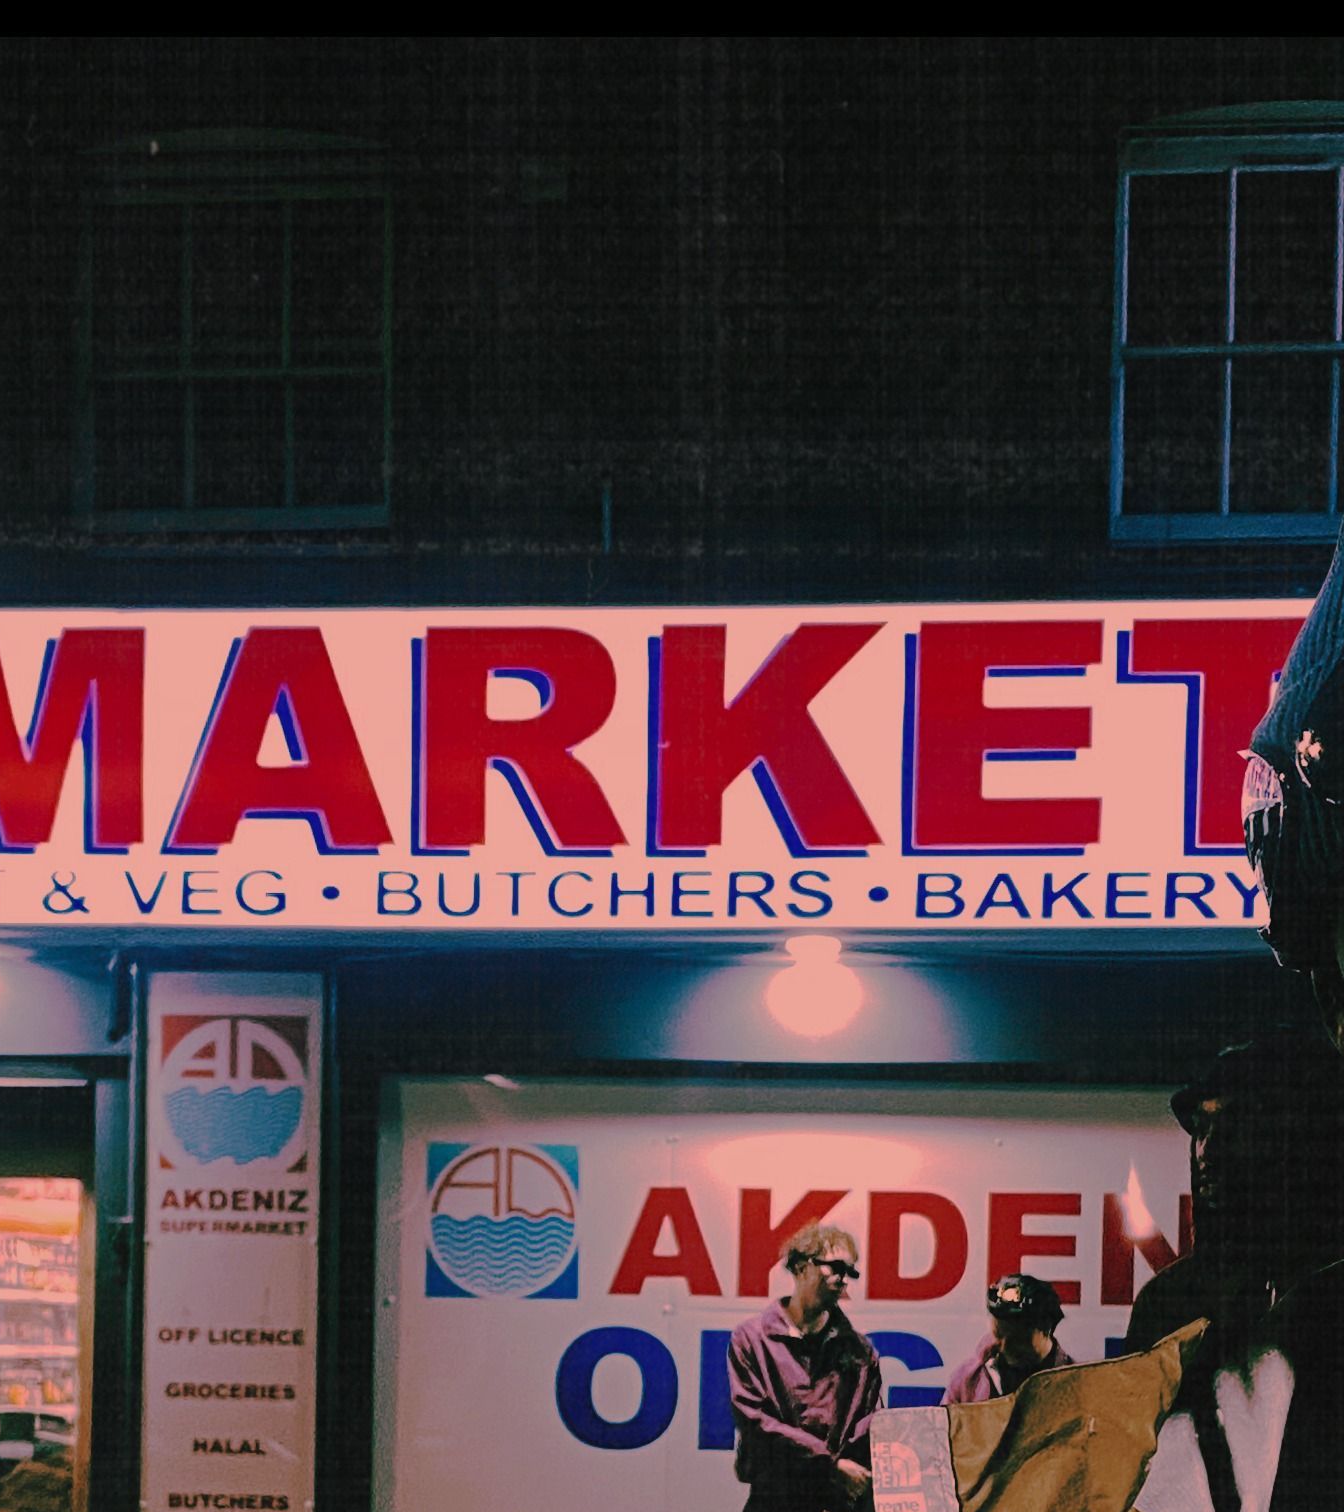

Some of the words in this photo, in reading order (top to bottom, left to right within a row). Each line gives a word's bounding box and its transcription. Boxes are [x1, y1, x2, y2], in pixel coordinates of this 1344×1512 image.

[42, 869, 91, 914] &
[124, 869, 287, 916] VEG
[376, 870, 834, 918] BUTCHERS
[914, 871, 1262, 919] BAKERY
[160, 1188, 310, 1214] AKDENIZ
[160, 1219, 308, 1237] SUPERMARKET
[607, 1185, 1196, 1306] AKDEN
[157, 1328, 200, 1344] OFF
[208, 1328, 306, 1347] LICENCE
[164, 1383, 297, 1401] GROCERIES
[191, 1438, 267, 1457] HALAL
[167, 1493, 290, 1512] BUTCHERS
